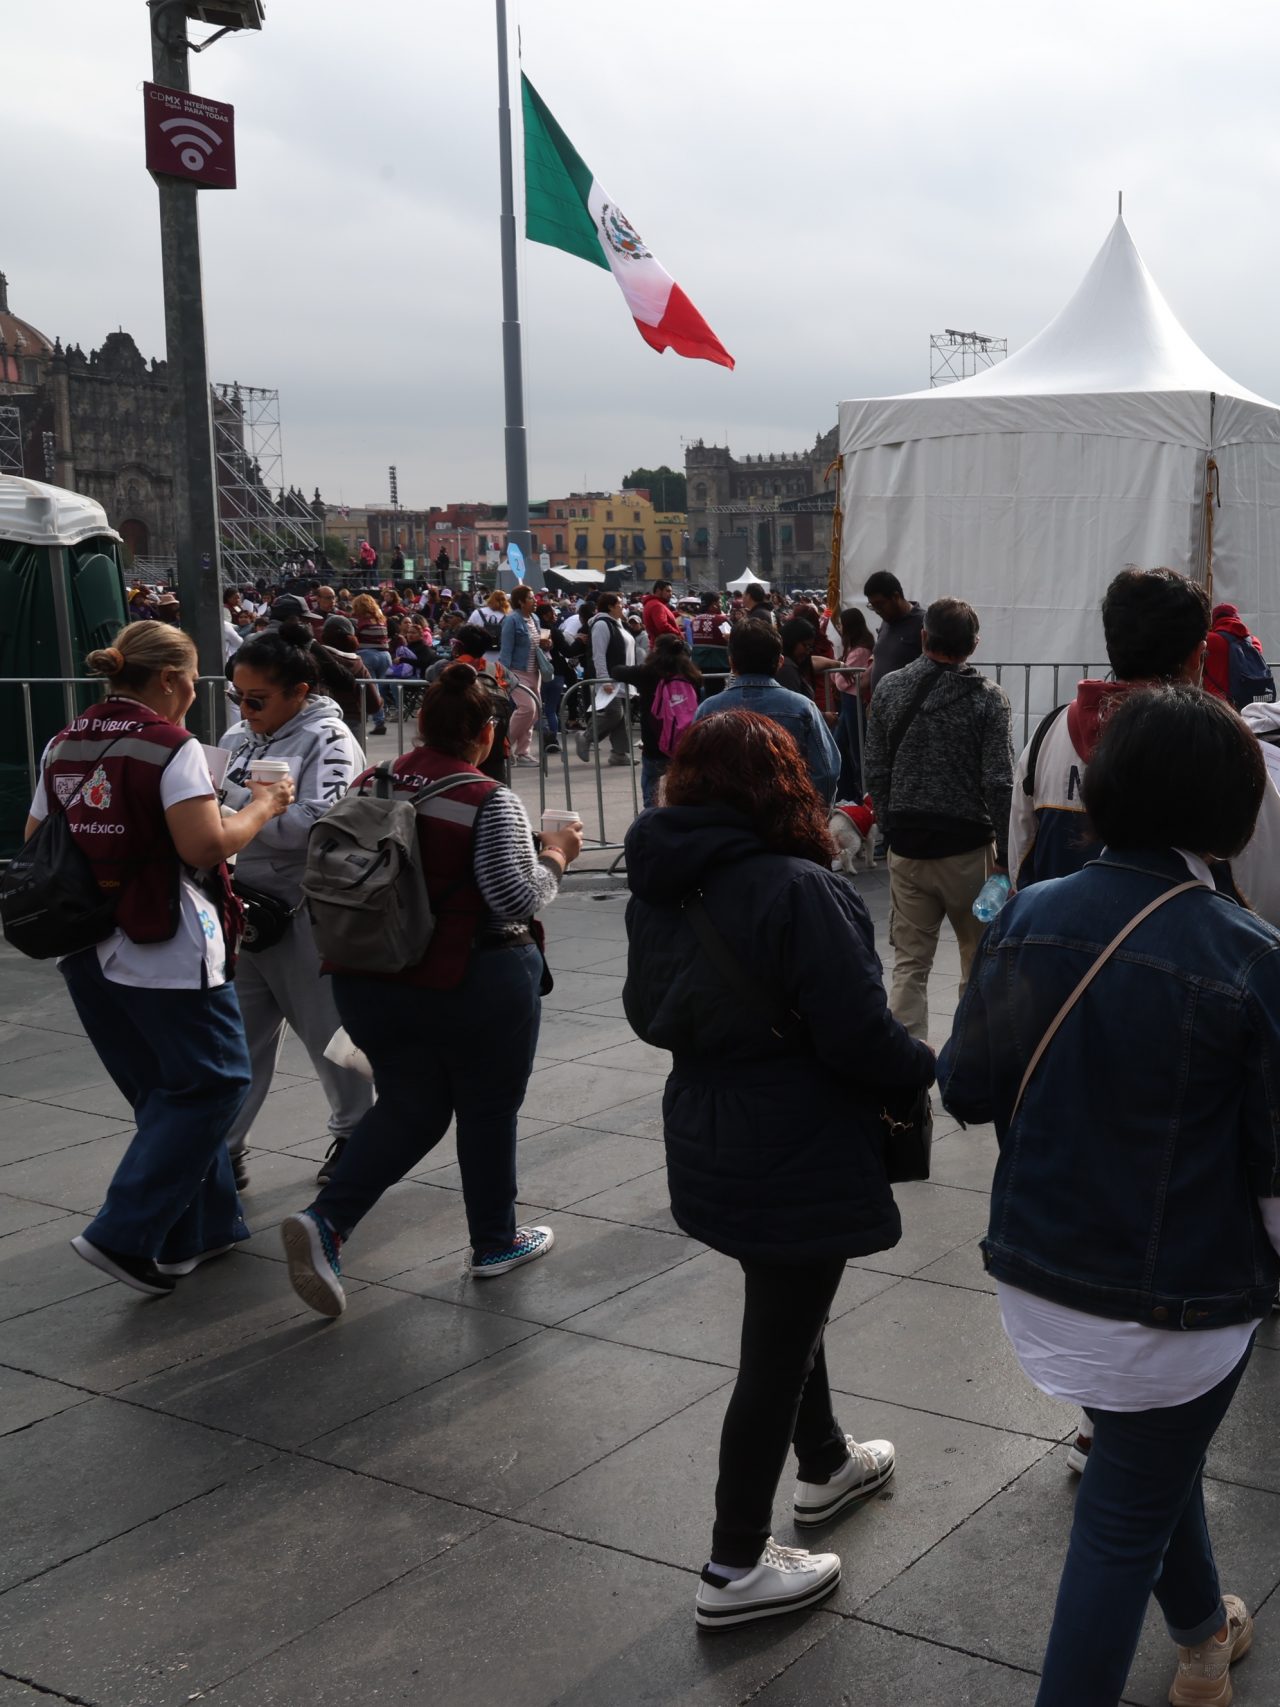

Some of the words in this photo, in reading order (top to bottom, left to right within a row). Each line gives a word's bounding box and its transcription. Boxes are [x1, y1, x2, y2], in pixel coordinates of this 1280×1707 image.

[150, 91, 180, 104] CDMX
[184, 100, 218, 113] INTERNET
[184, 106, 204, 115] PARA
[206, 112, 229, 122] TODAS
[80, 821, 125, 834] MÉXICO
